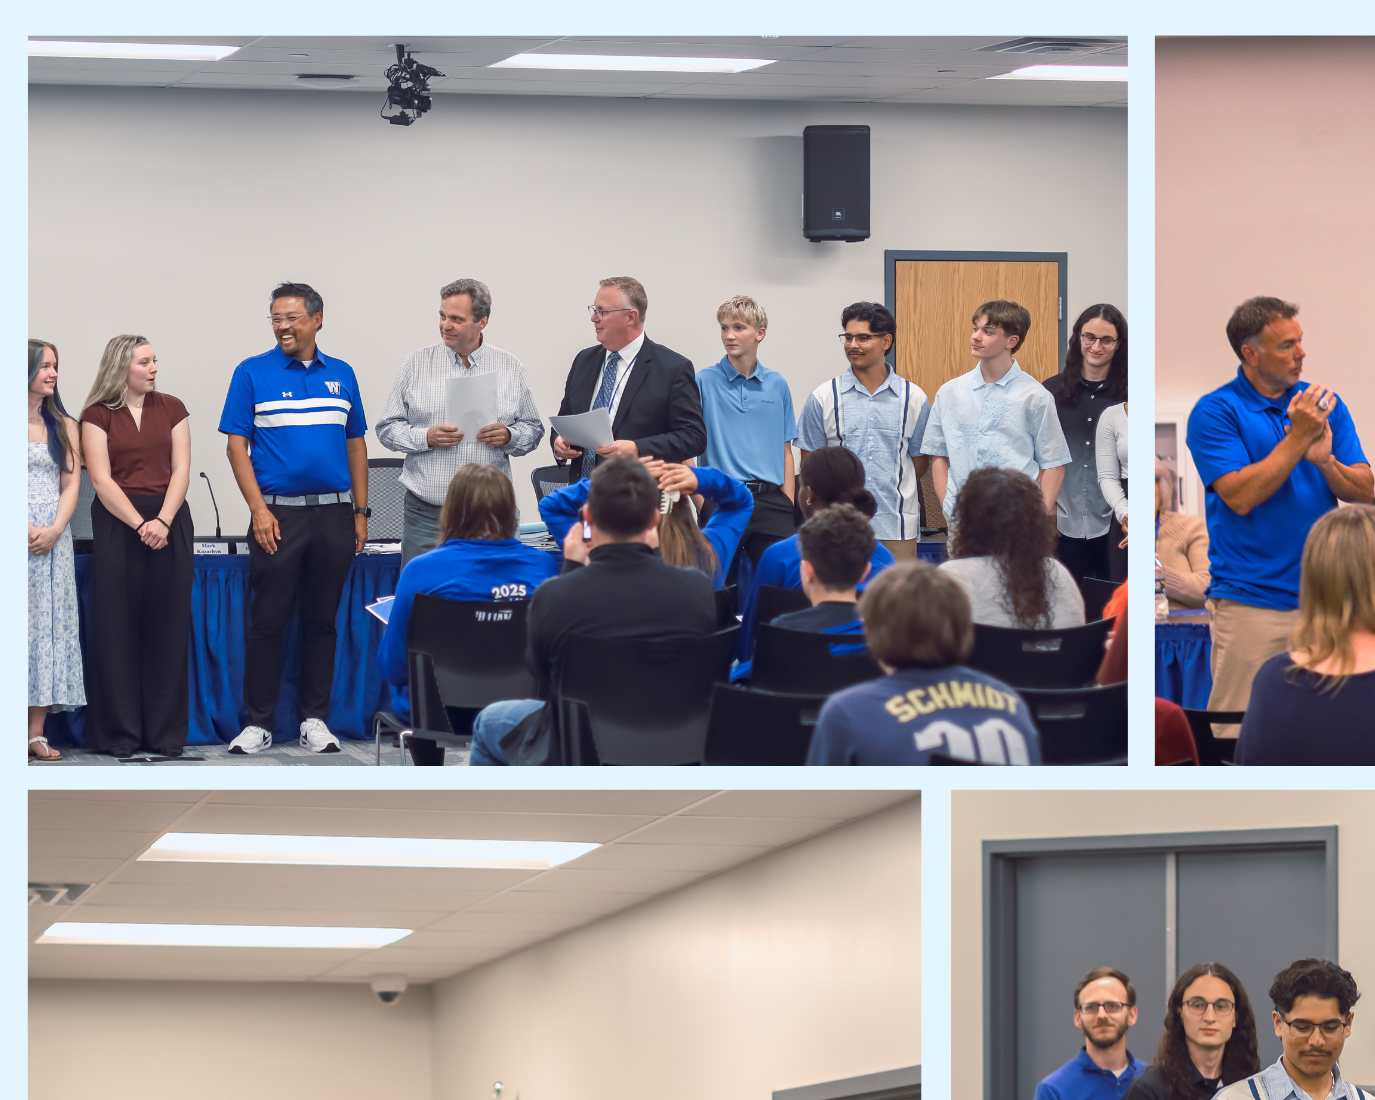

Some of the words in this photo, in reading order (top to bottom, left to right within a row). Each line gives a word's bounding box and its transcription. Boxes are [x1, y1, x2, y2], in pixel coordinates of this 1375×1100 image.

[324, 380, 341, 395] W
[491, 584, 527, 599] 2025
[885, 680, 1018, 723] SCHMIDT
